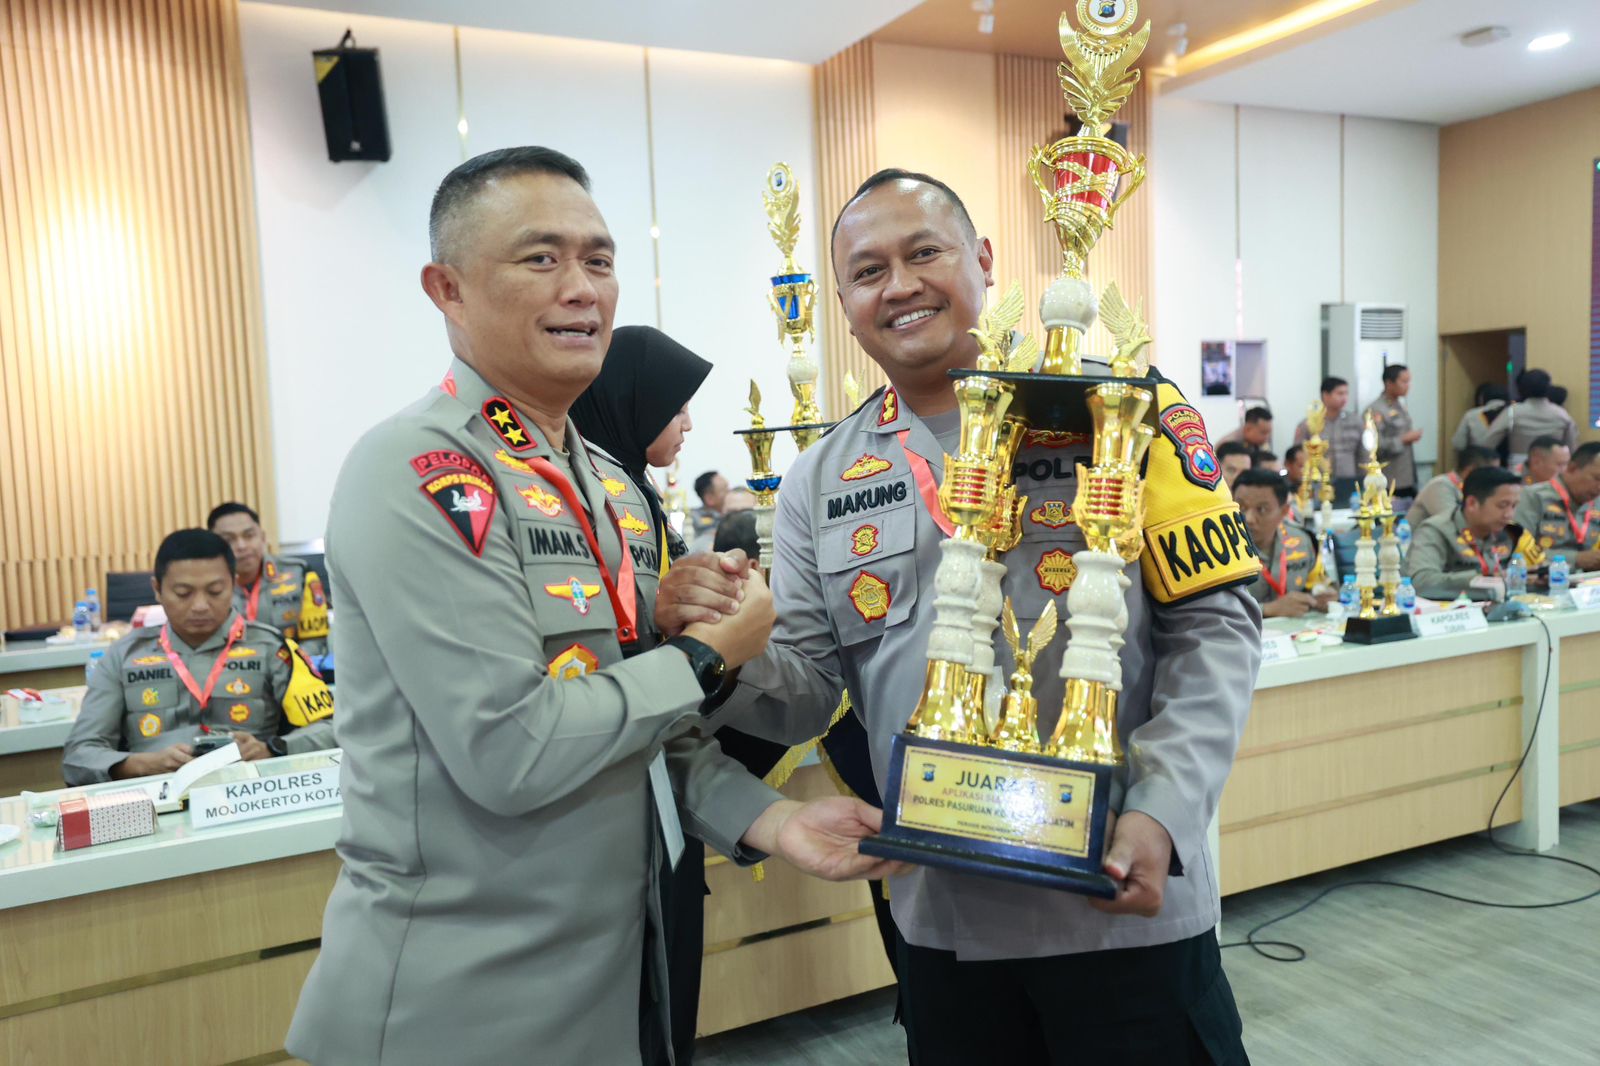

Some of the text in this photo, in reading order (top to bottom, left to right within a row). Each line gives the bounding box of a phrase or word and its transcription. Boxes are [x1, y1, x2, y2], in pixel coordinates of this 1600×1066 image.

[827, 480, 907, 519] MAKUNG
[528, 527, 590, 559] IMAM.S
[127, 668, 173, 683] DANIEL
[223, 660, 261, 671] OLRI
[226, 772, 323, 799] KAPOLRES
[205, 793, 301, 819] MOJOKERTO
[912, 794, 945, 809] POLRES
[946, 799, 992, 816] PASURUAN
